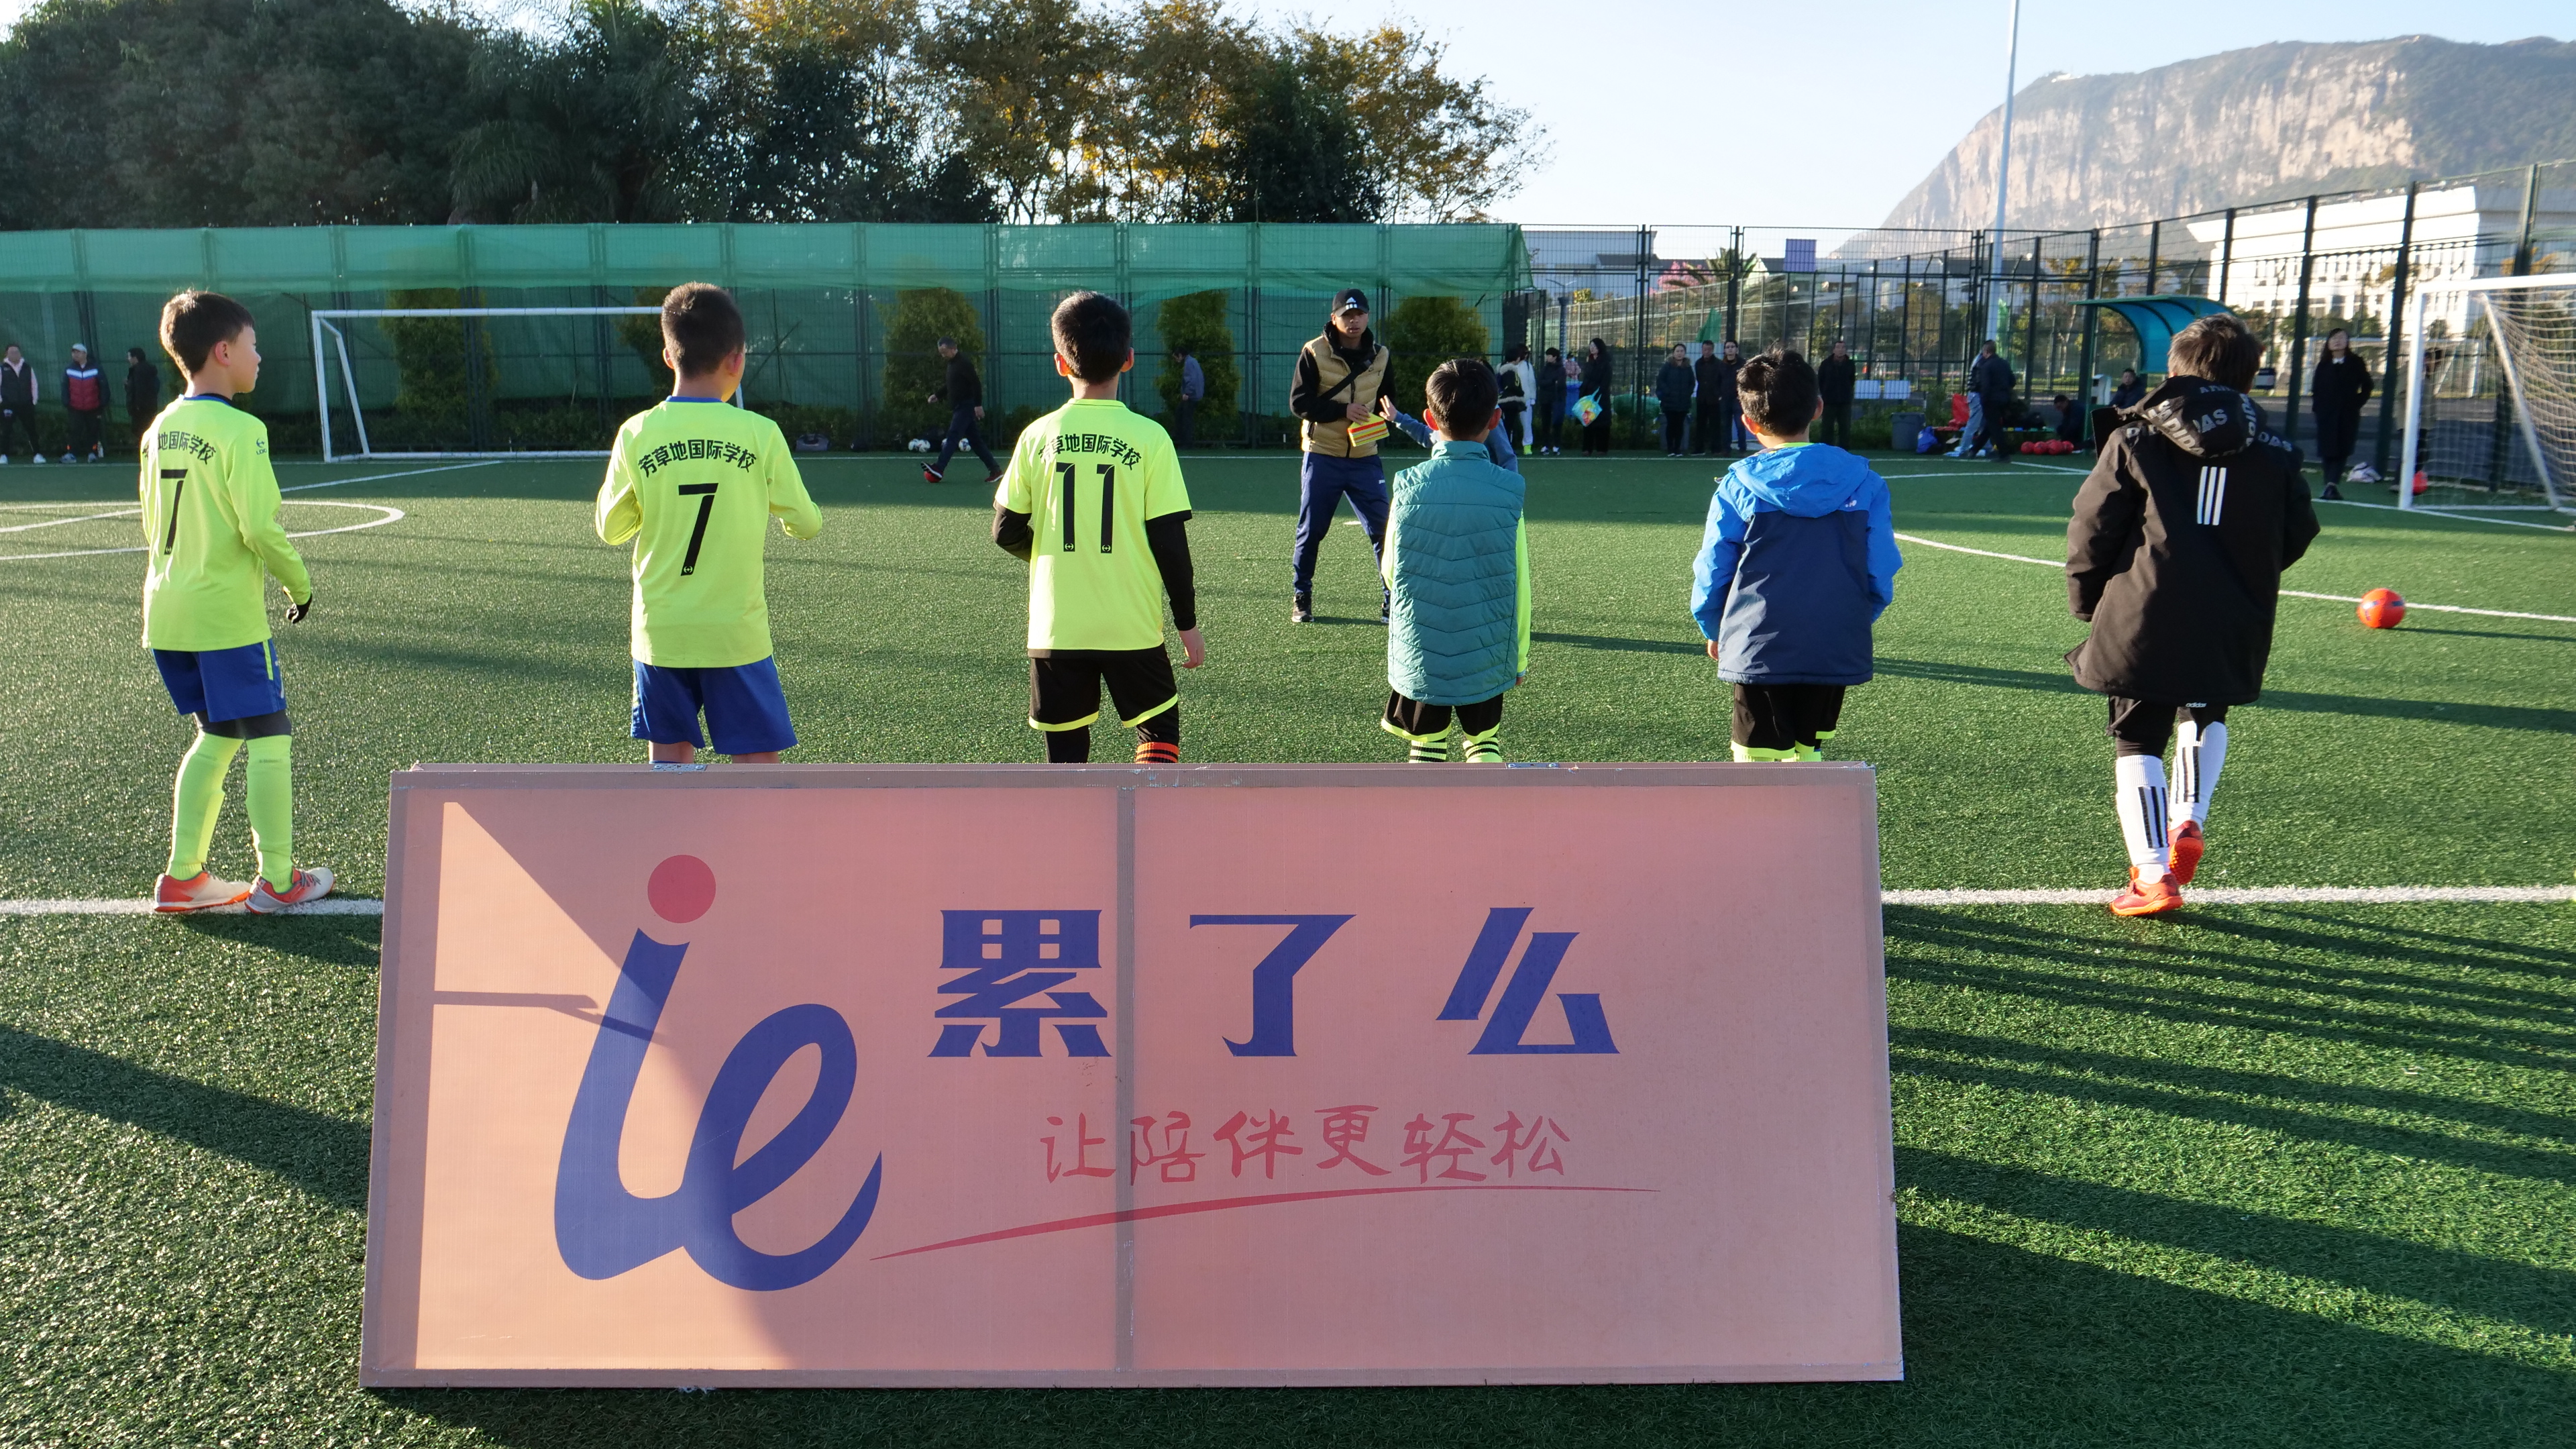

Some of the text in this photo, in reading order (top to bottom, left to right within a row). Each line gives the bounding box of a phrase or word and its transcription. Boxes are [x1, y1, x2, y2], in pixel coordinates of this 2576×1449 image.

[142, 431, 216, 465] 地国际学校
[638, 439, 757, 478] 芳草地国际学校
[160, 469, 189, 555] 7
[678, 482, 719, 576] 7
[1056, 462, 1115, 554] 11
[927, 907, 1620, 1058] 累了么
[1040, 1104, 1570, 1185] 让陪伴更轻松
